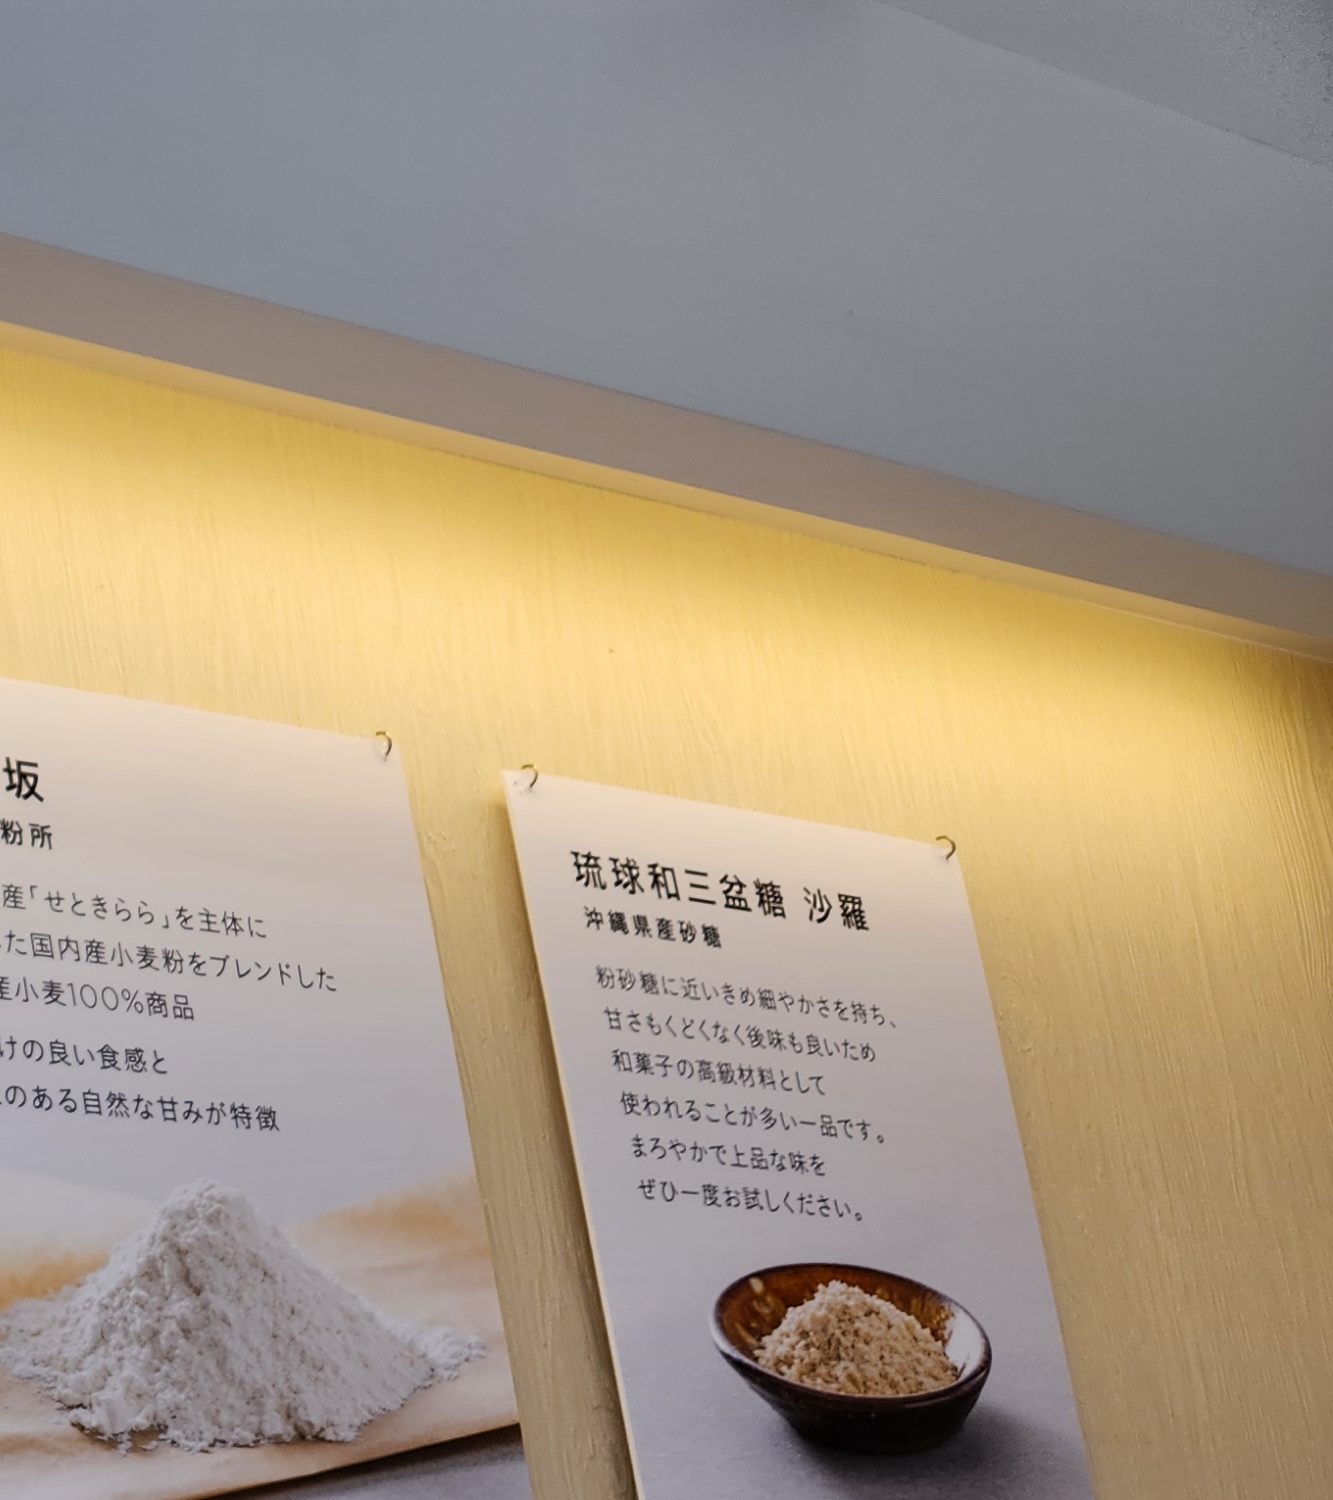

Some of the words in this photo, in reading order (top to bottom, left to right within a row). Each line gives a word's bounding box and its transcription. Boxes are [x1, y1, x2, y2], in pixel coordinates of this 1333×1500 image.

[571, 851, 784, 917] 琉球和三盆糖
[804, 888, 868, 928] 沙羅
[583, 907, 720, 945] 沖縄県産砂糖
[595, 966, 896, 1026] 粉砂糖に近いきめ細やかさを持ち、
[604, 1008, 874, 1059] 甘さもくどくなく後味も良いため
[611, 1050, 824, 1093] 和菓子の高級材料として
[620, 1092, 883, 1141] 使われることが多い一品です。
[631, 1135, 824, 1174] まろやかで上品な味を
[637, 1180, 861, 1219] ぜひ一度お試しください。
